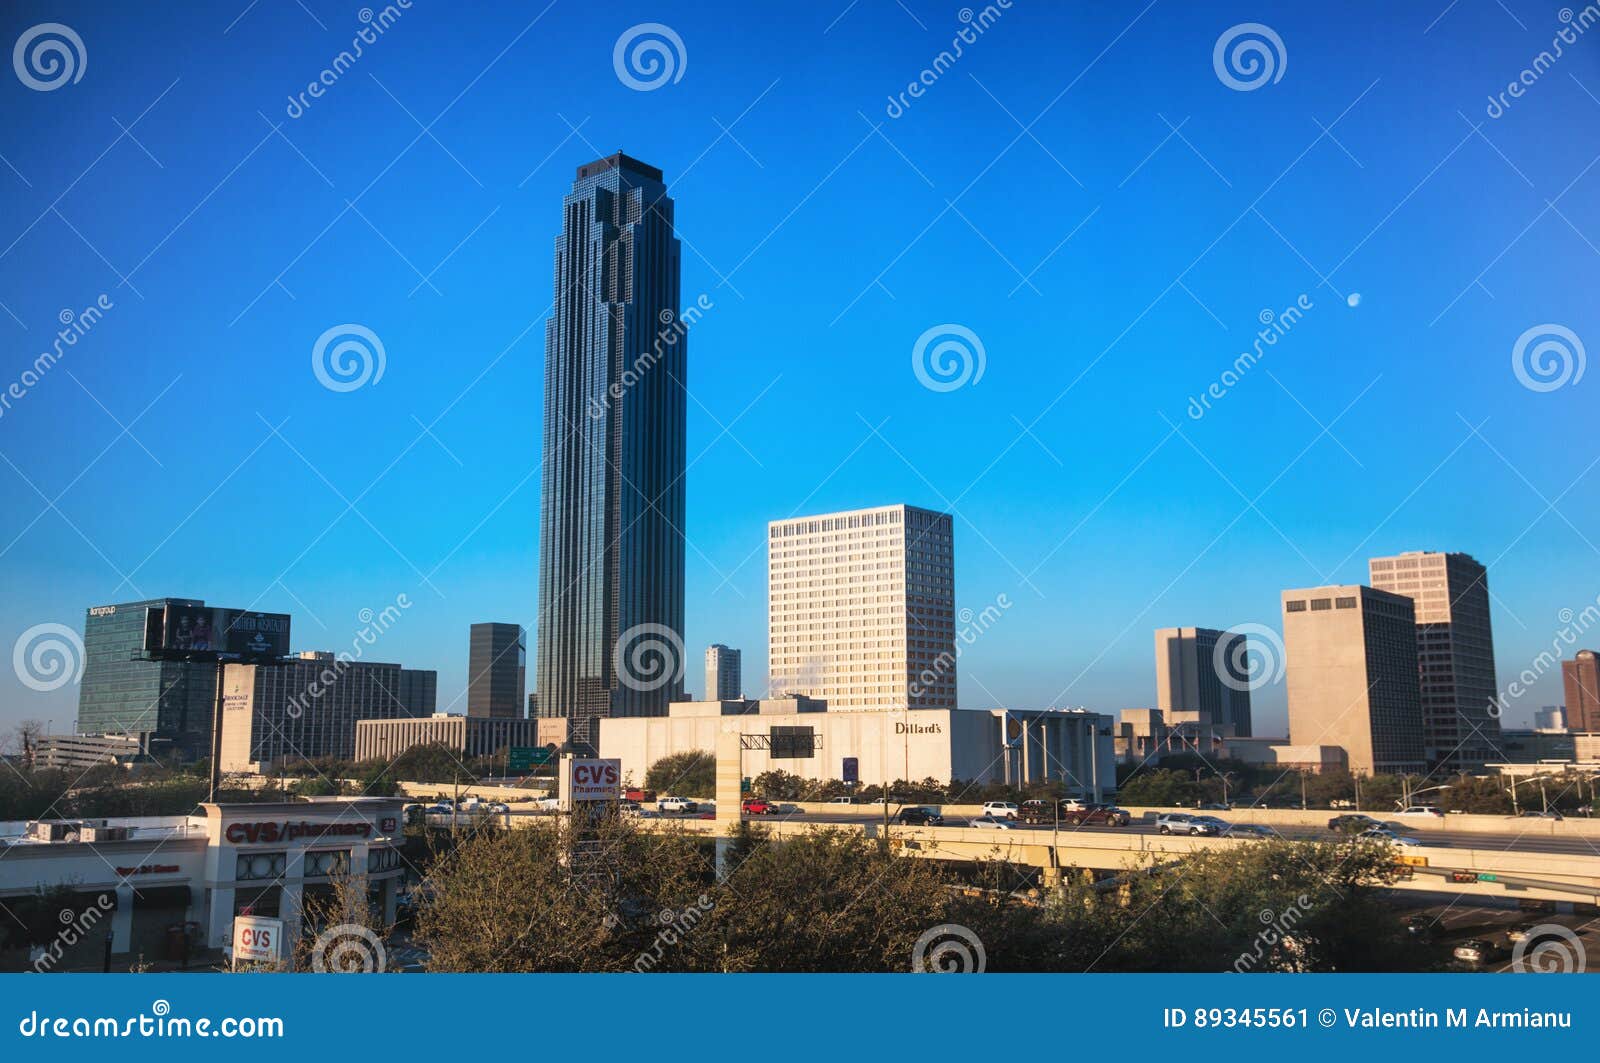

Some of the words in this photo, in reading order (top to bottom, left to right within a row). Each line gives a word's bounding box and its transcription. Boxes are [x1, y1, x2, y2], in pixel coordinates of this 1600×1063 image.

[895, 722, 941, 734] Dillard's
[574, 765, 617, 785] CVS
[573, 786, 616, 794] Pharmacy
[226, 820, 373, 843] CVS/pharmacy
[242, 928, 270, 947] CVS
